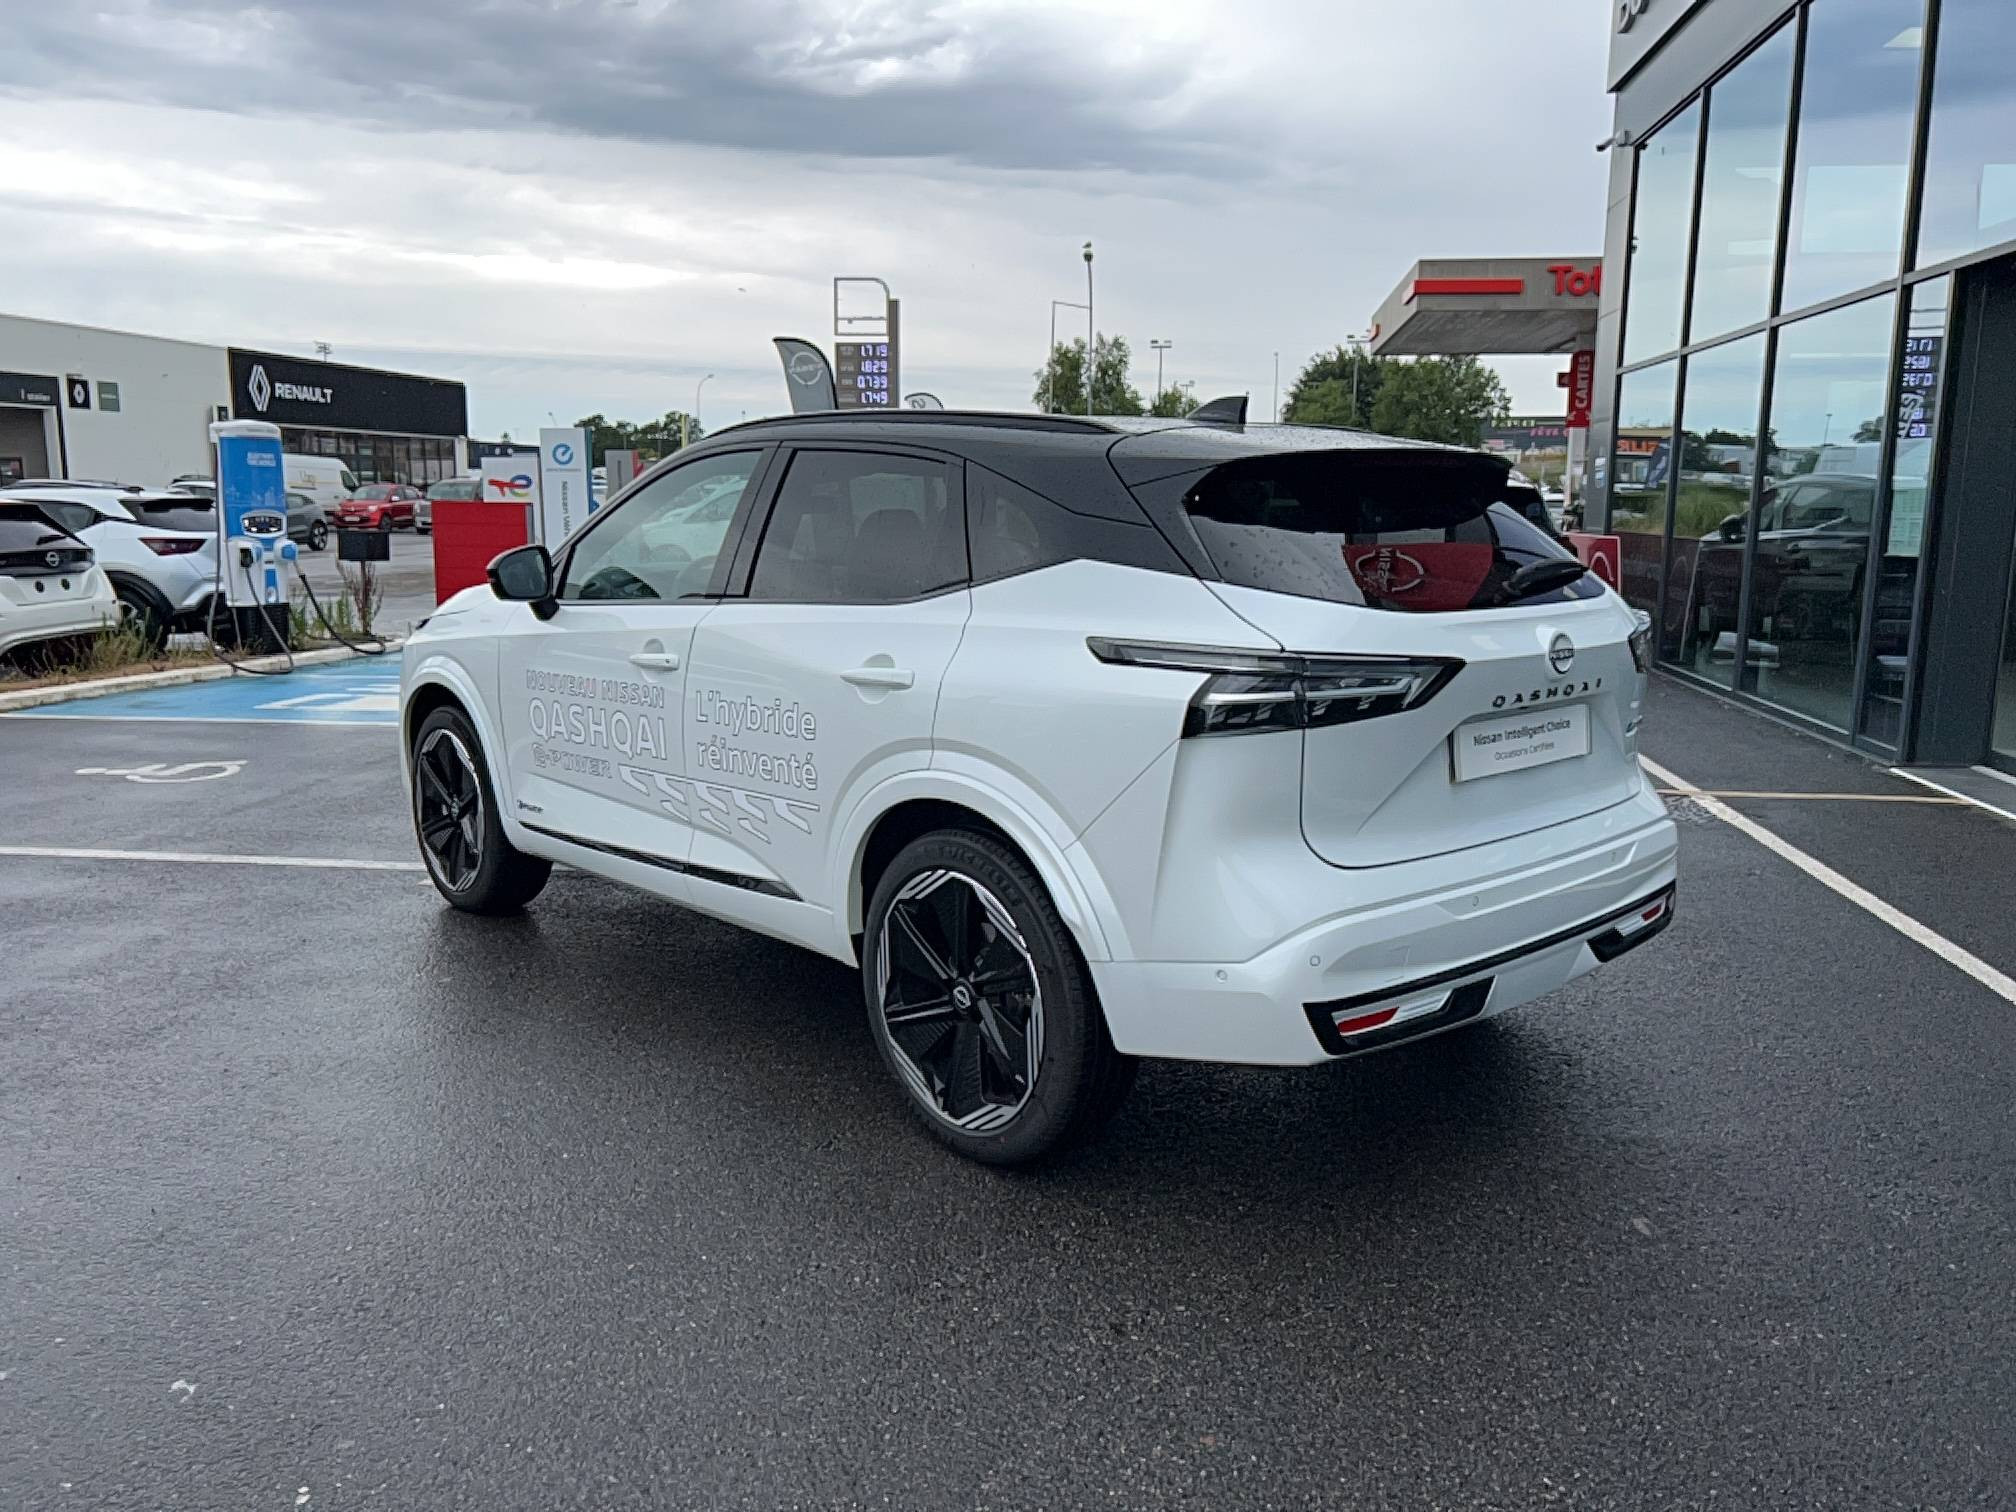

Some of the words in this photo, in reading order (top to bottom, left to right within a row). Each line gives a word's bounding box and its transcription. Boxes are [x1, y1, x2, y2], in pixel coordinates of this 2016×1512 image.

[275, 383, 333, 403] RENAULT
[1575, 354, 1591, 409] CARTES
[526, 669, 597, 699] NOUVEAU
[601, 679, 665, 709] NISSAN
[1492, 678, 1602, 708] QASHQAI
[529, 696, 667, 761] QASHQAI
[696, 690, 816, 740] L'hybride
[1473, 732, 1503, 747] Nissan
[1504, 724, 1546, 739] Intelligent
[1546, 718, 1571, 732] Choice
[696, 734, 818, 791] réinventé
